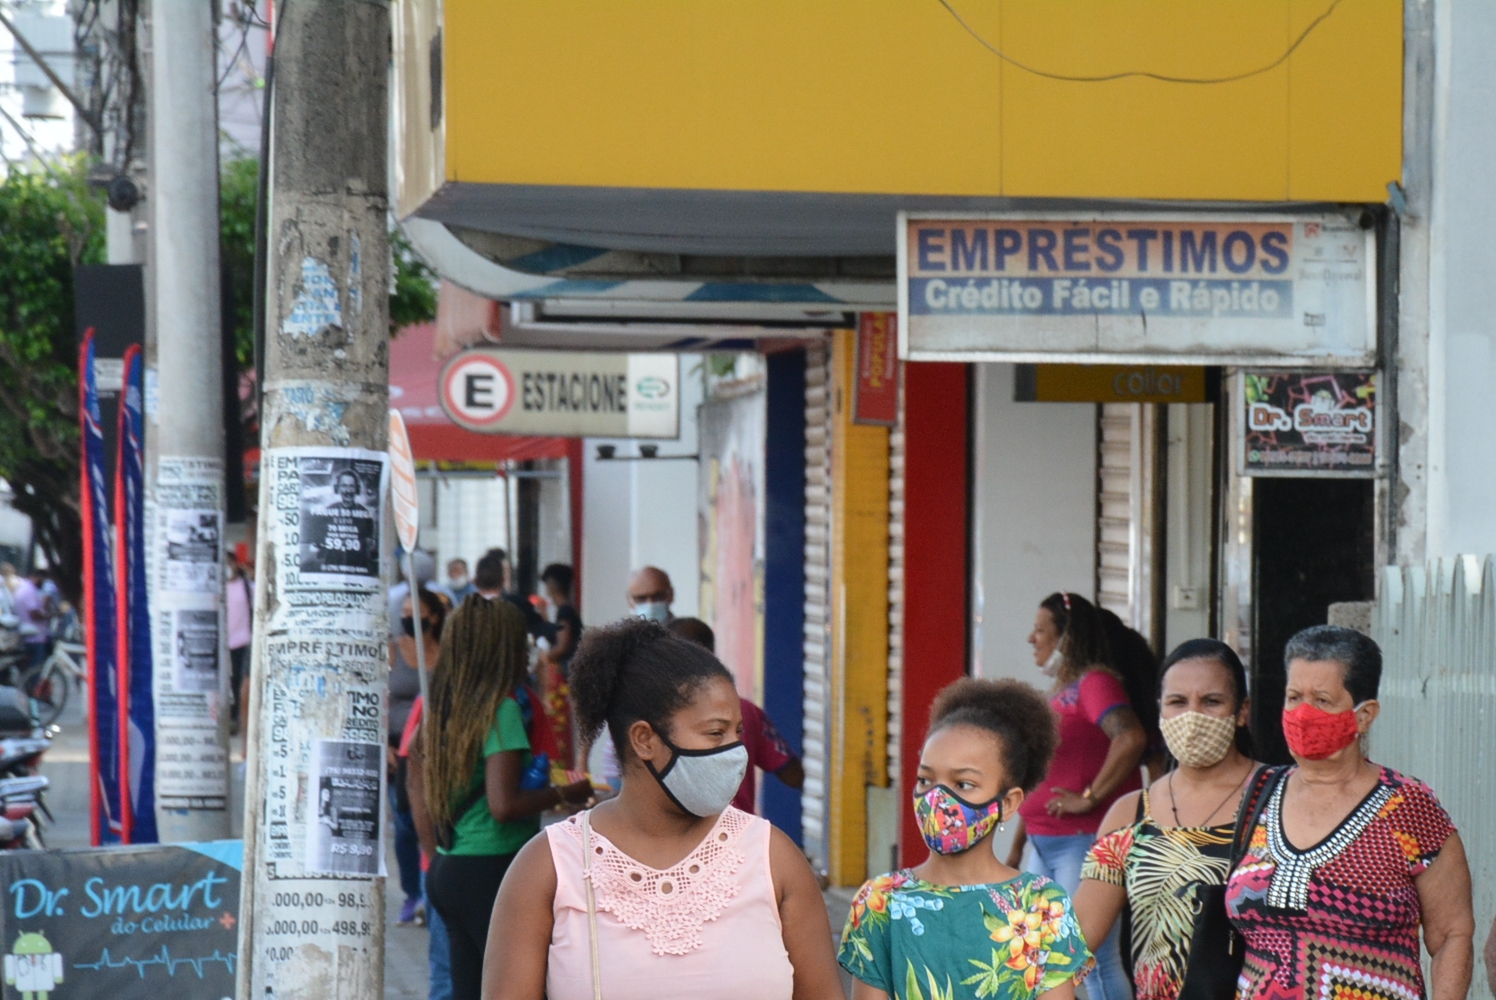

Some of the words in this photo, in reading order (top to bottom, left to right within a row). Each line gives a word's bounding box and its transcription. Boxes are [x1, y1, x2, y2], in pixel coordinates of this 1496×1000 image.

[926, 278, 1042, 310] Crédito
[1052, 279, 1129, 310] Fácil
[1140, 287, 1159, 310] e
[1170, 280, 1280, 316] Rápido
[465, 375, 493, 408] E
[523, 372, 627, 413] ESTACIONE
[1251, 404, 1291, 430] Dr.
[1296, 405, 1371, 431] Smart
[325, 537, 361, 552] 59,90
[353, 705, 379, 718] NO
[9, 879, 69, 919] Dr.
[80, 871, 228, 918] Smart
[111, 916, 137, 934] do
[141, 912, 215, 933] Celular
